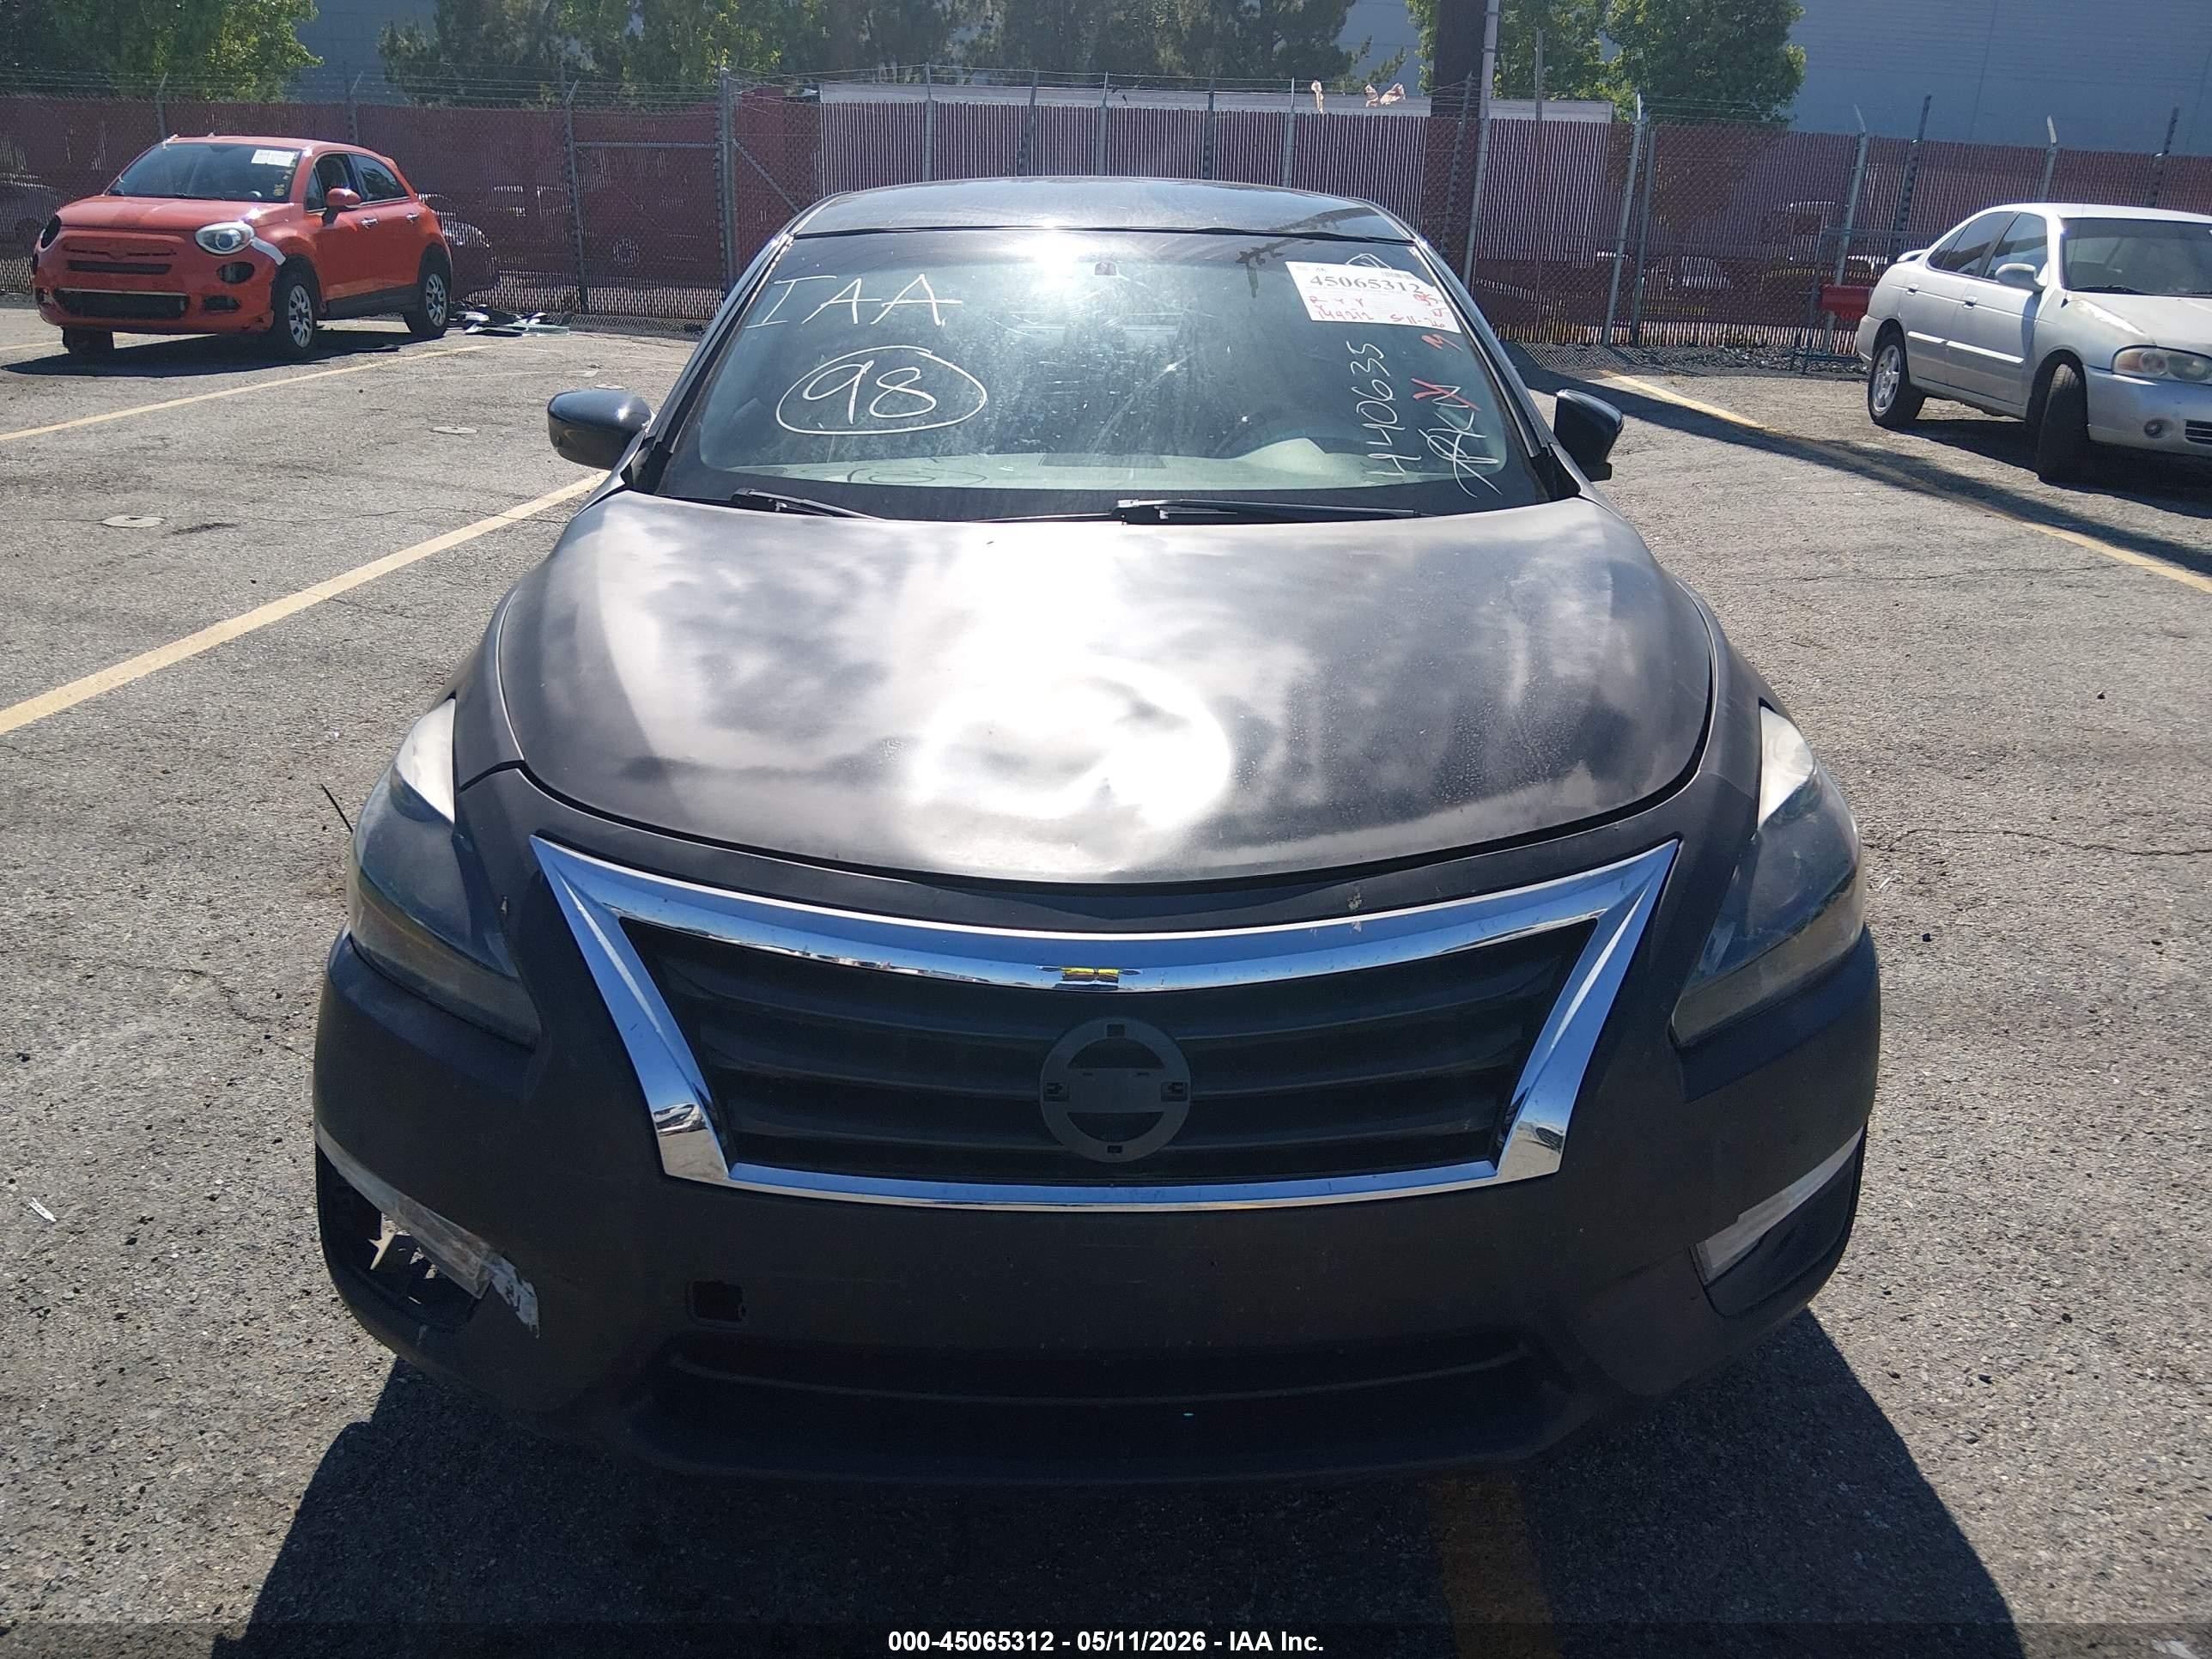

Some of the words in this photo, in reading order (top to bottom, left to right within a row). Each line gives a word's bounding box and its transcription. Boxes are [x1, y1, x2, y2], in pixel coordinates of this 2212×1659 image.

[744, 273, 963, 330] IAA
[1310, 275, 1424, 295] 45065312
[802, 359, 937, 425] 98
[1346, 340, 1422, 476] 440635
